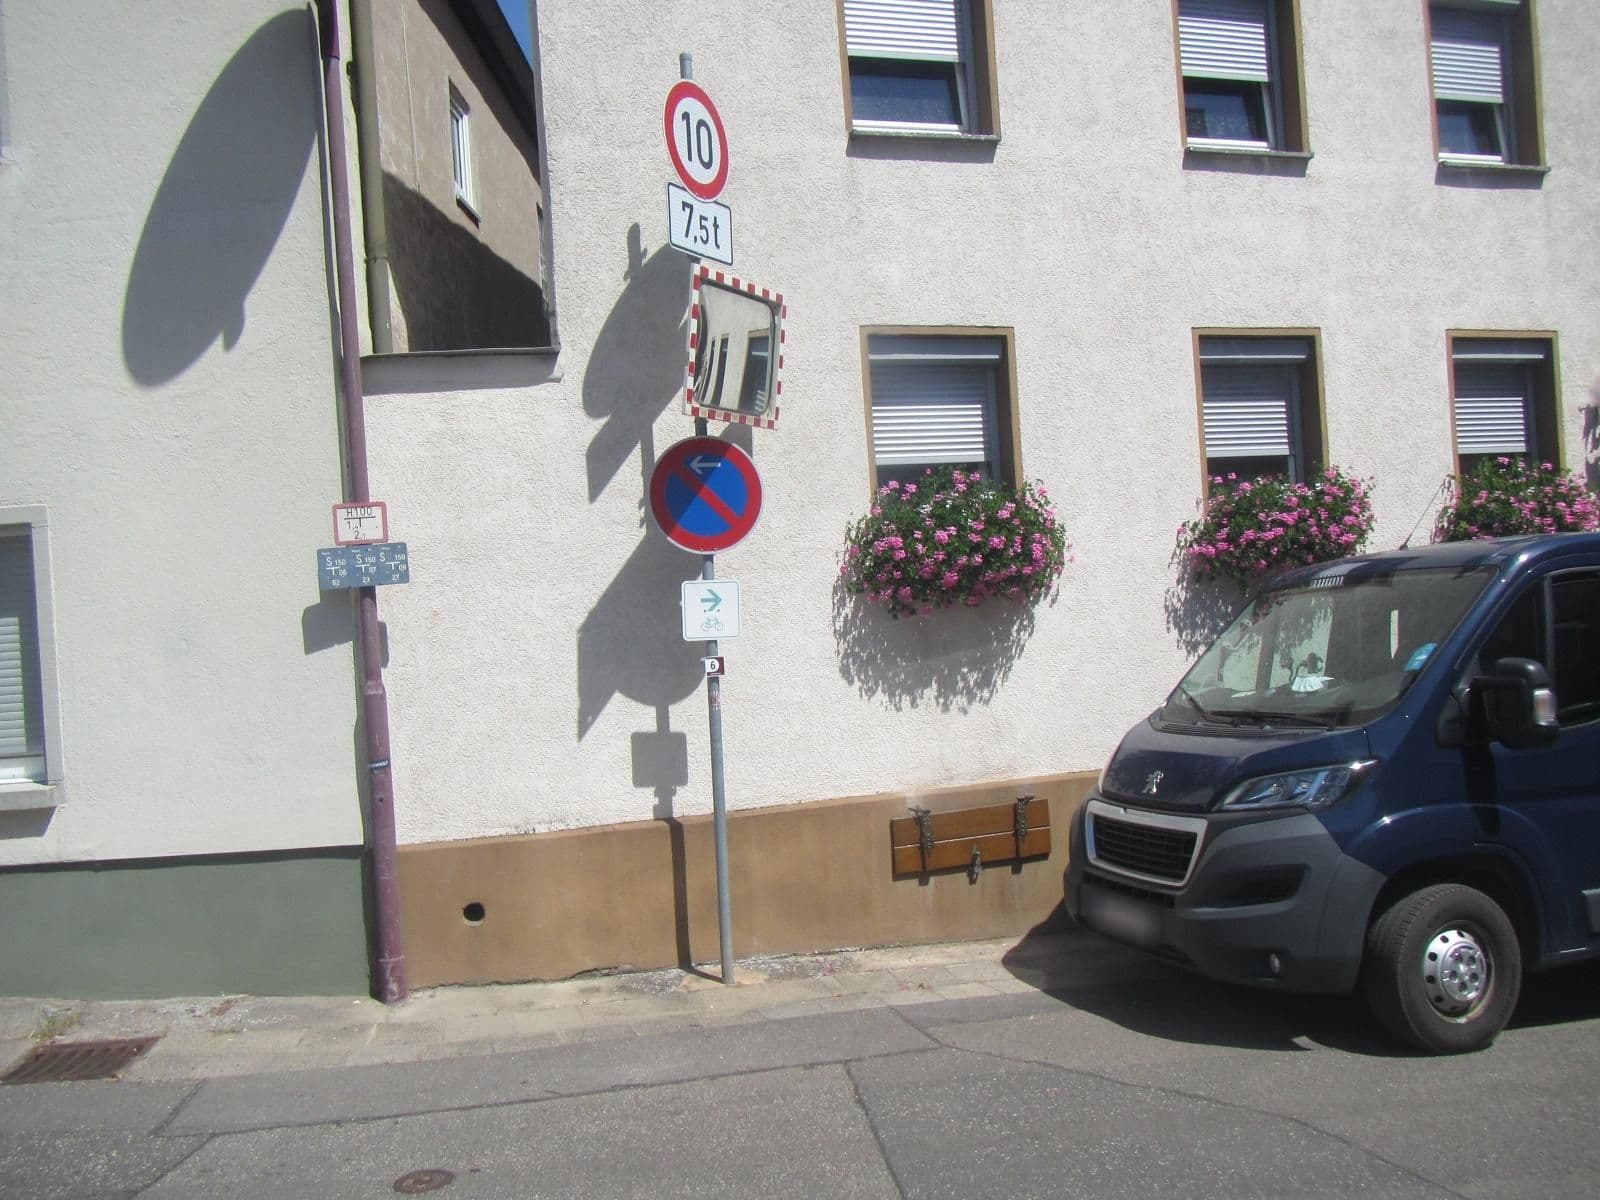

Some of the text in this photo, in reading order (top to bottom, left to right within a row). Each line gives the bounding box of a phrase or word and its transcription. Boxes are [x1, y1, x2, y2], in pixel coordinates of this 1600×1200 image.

[681, 111, 713, 170] 10
[326, 556, 333, 567] S
[355, 554, 362, 564] S
[379, 552, 386, 562] S
[710, 661, 716, 670] 6
